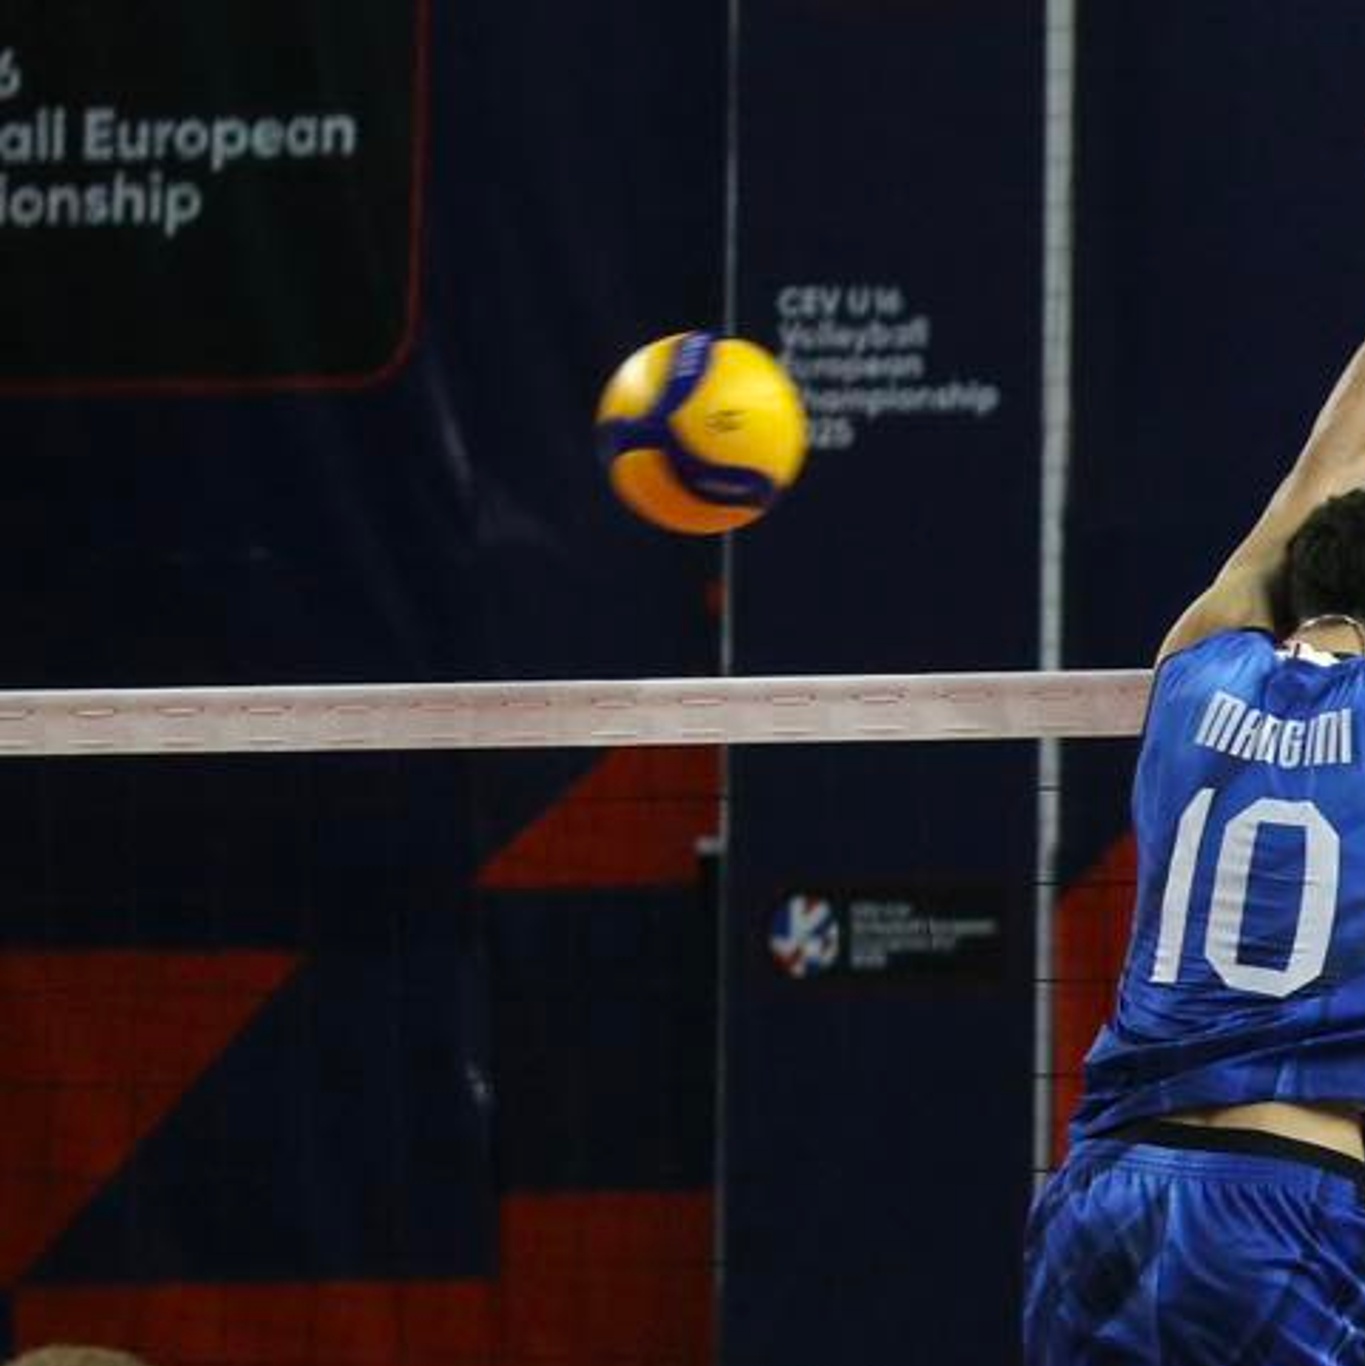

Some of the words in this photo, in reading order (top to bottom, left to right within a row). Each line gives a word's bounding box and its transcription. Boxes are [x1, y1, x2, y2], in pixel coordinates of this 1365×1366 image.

[85, 106, 358, 172] European
[776, 284, 840, 317] CEV
[1150, 787, 1340, 998] 10
